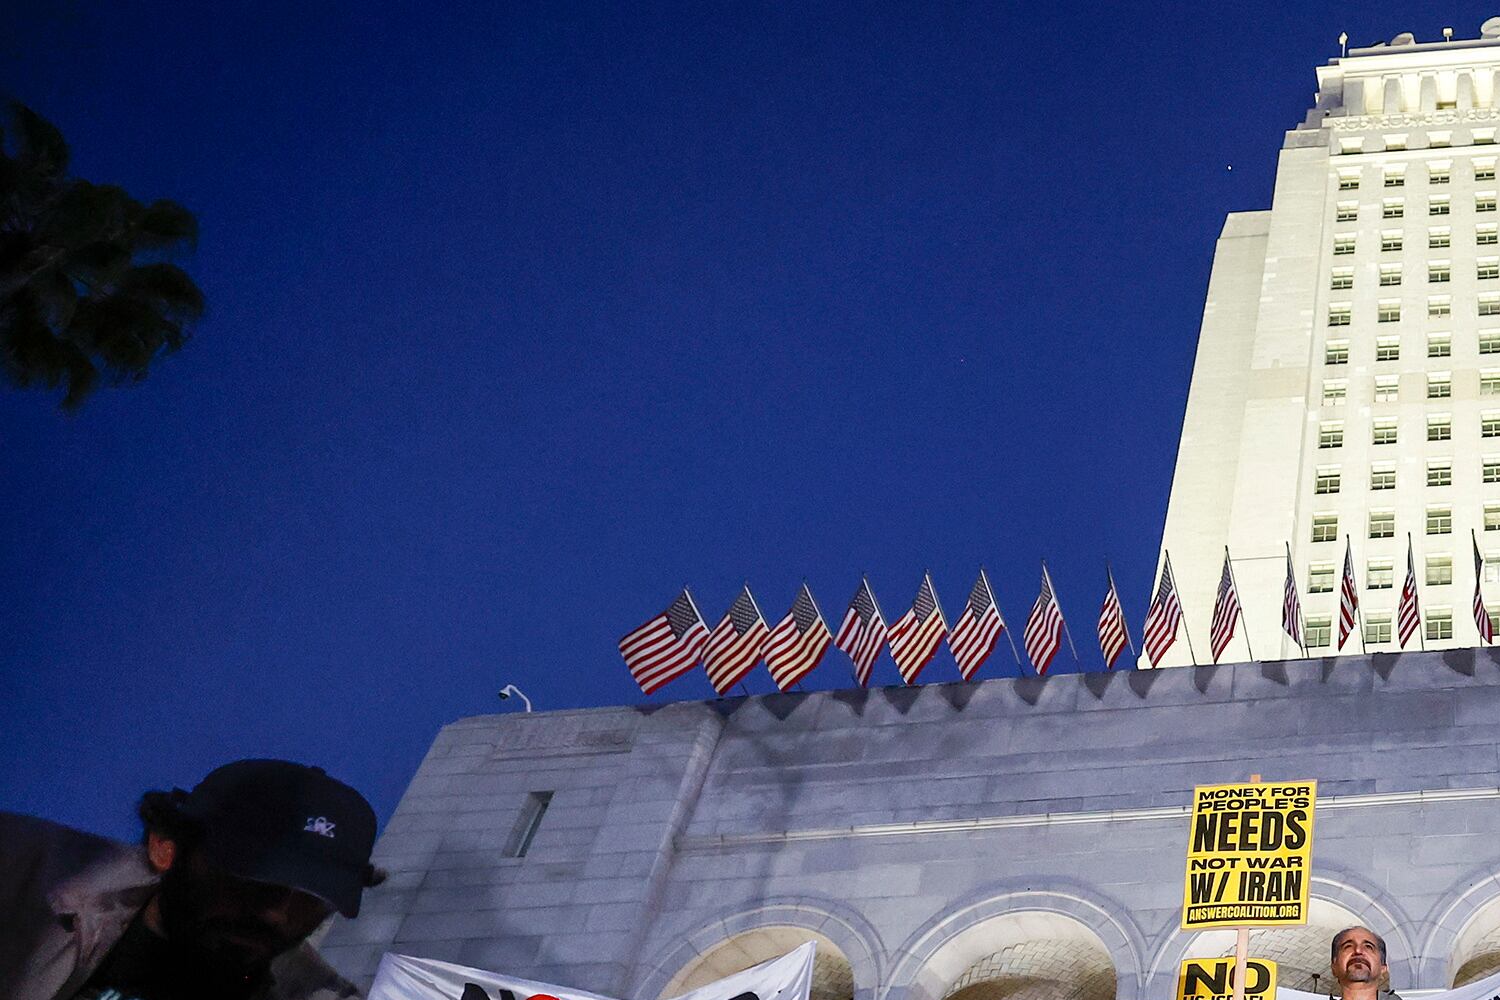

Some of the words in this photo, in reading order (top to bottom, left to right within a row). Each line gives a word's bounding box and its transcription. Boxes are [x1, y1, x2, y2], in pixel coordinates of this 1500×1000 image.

[1200, 788, 1266, 800] MONEY
[1272, 787, 1310, 796] FOR
[1198, 798, 1309, 812] PEOPLE'S
[1193, 810, 1306, 852] NEEDS
[1191, 858, 1241, 870] NOT
[1246, 856, 1302, 868] WAR
[1191, 872, 1230, 904] W/
[1239, 870, 1302, 901] IRAN
[1189, 906, 1298, 921] ANSWERCOALITION.ORG
[1184, 962, 1270, 995] NO
